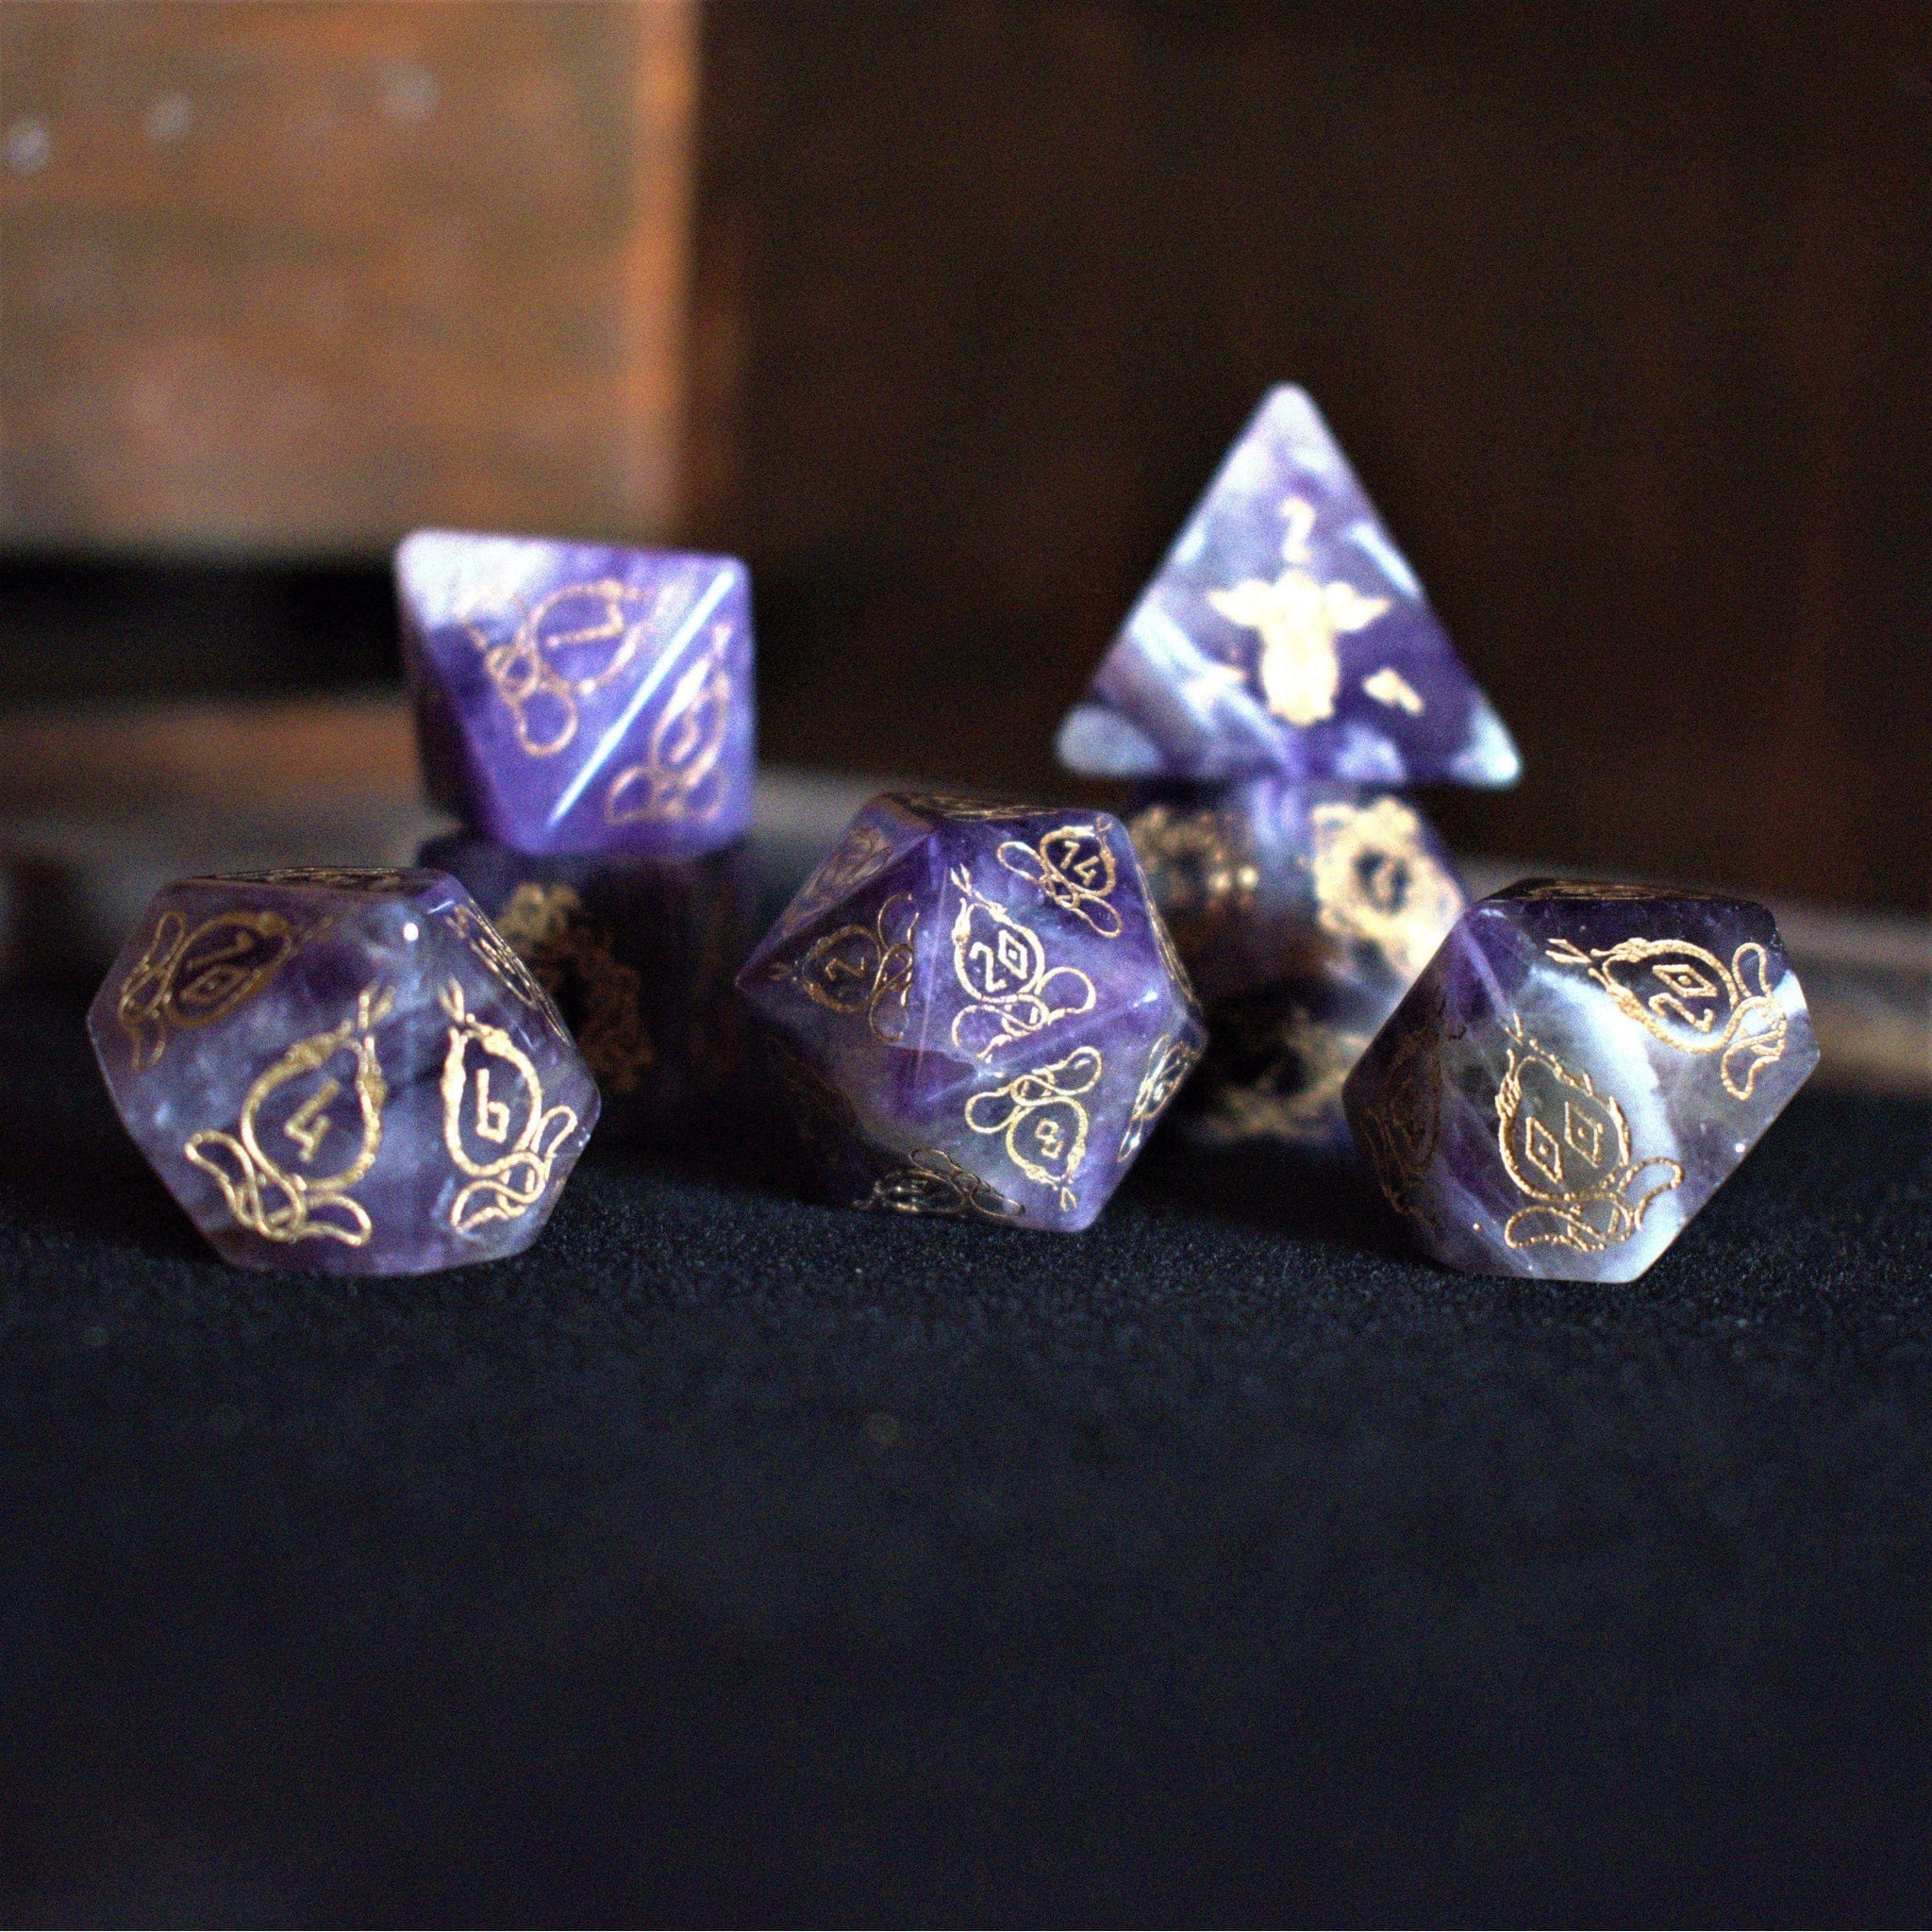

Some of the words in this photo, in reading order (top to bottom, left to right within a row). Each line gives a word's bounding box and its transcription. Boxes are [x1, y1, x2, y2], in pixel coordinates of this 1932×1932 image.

[1060, 841, 1100, 886] 14
[969, 929, 1028, 992] 20
[1649, 963, 1718, 1034] 20
[285, 1078, 341, 1162] 4
[476, 1068, 509, 1143] 6
[1525, 1101, 1603, 1183] 00
